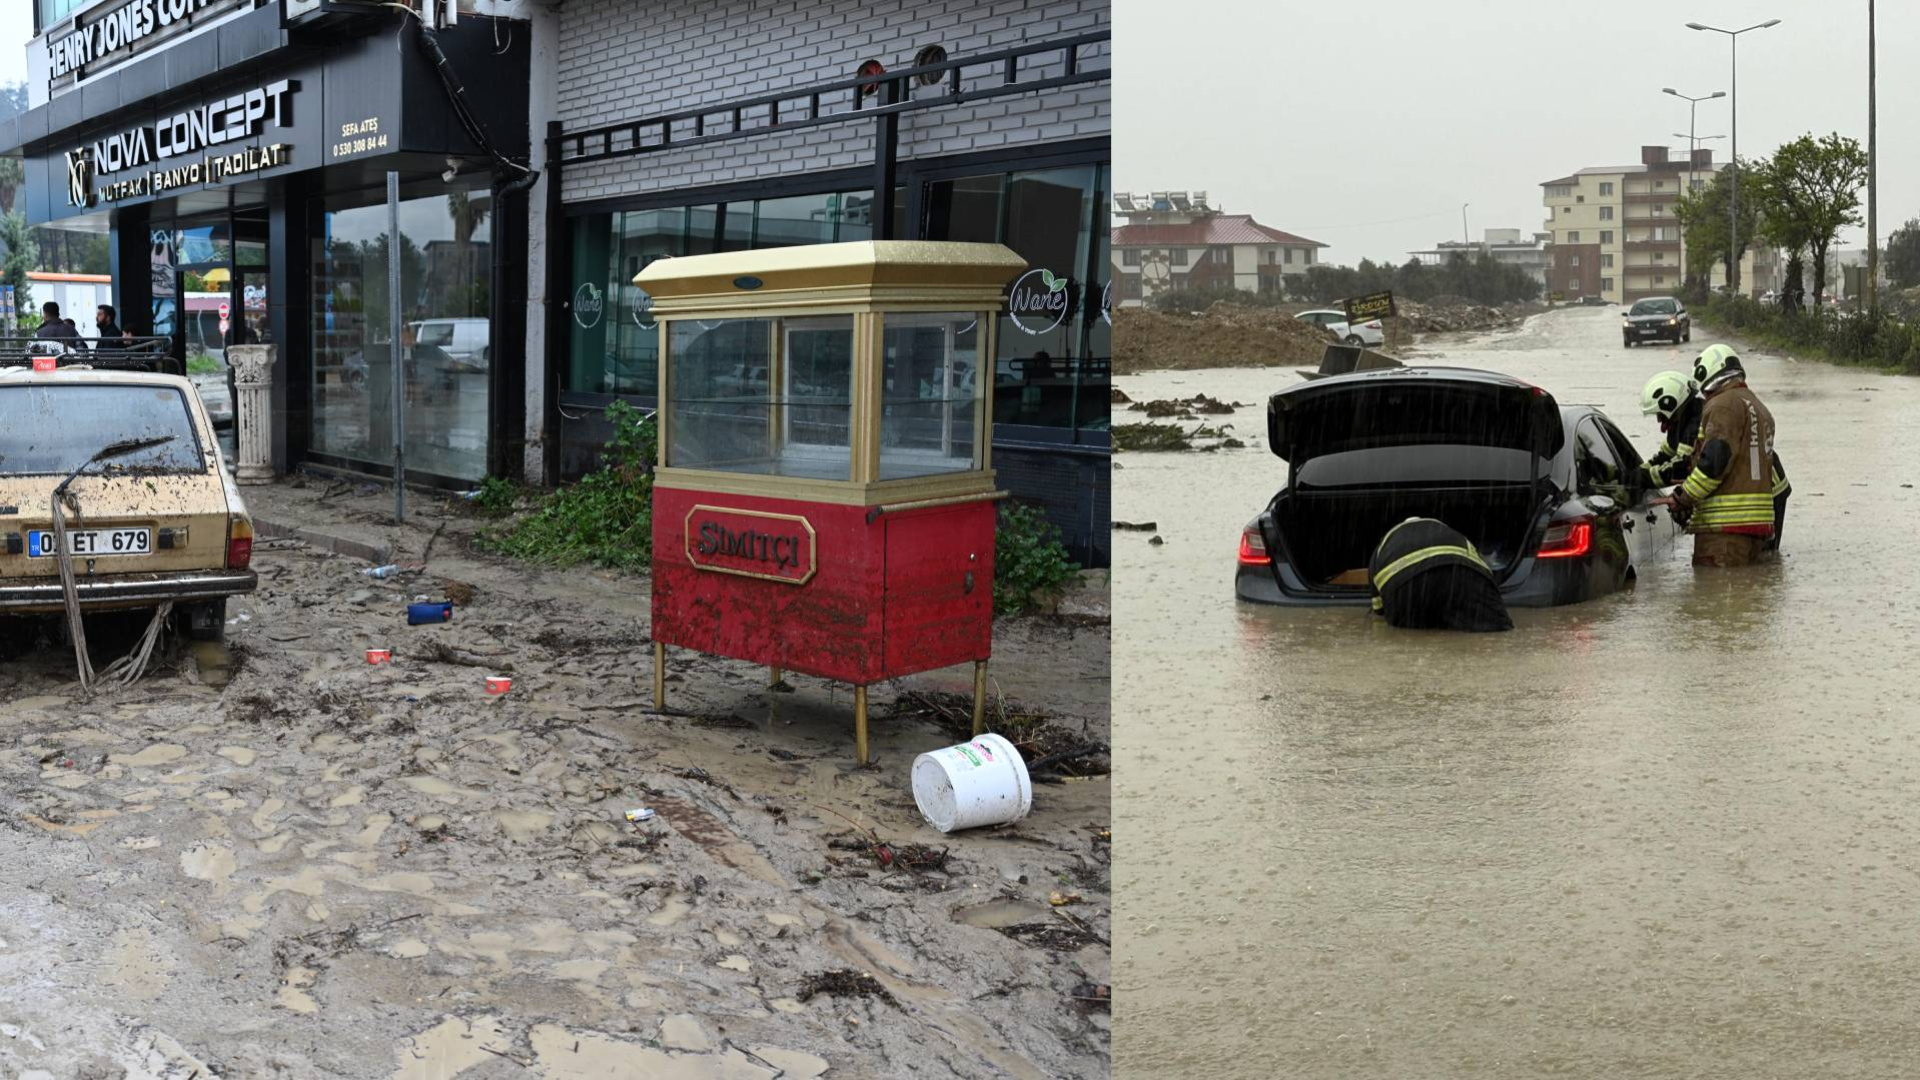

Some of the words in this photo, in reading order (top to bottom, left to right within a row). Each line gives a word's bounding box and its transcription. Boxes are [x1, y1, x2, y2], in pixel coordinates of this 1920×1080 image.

[48, 24, 95, 79] HENRY
[96, 0, 154, 57] JONES
[94, 126, 149, 175] NOVA
[156, 79, 289, 158] CONCEPT
[342, 123, 358, 137] SEFA
[333, 144, 338, 157] 0
[339, 142, 351, 156] 530
[353, 139, 366, 153] 308
[367, 136, 376, 150] 84
[378, 134, 387, 147] 44
[99, 177, 141, 202] MUTFAK
[155, 163, 199, 190] BANYO
[215, 143, 284, 177] TADİLAT
[1013, 287, 1064, 311] Nane
[74, 532, 97, 551] ET
[112, 531, 148, 551] 679
